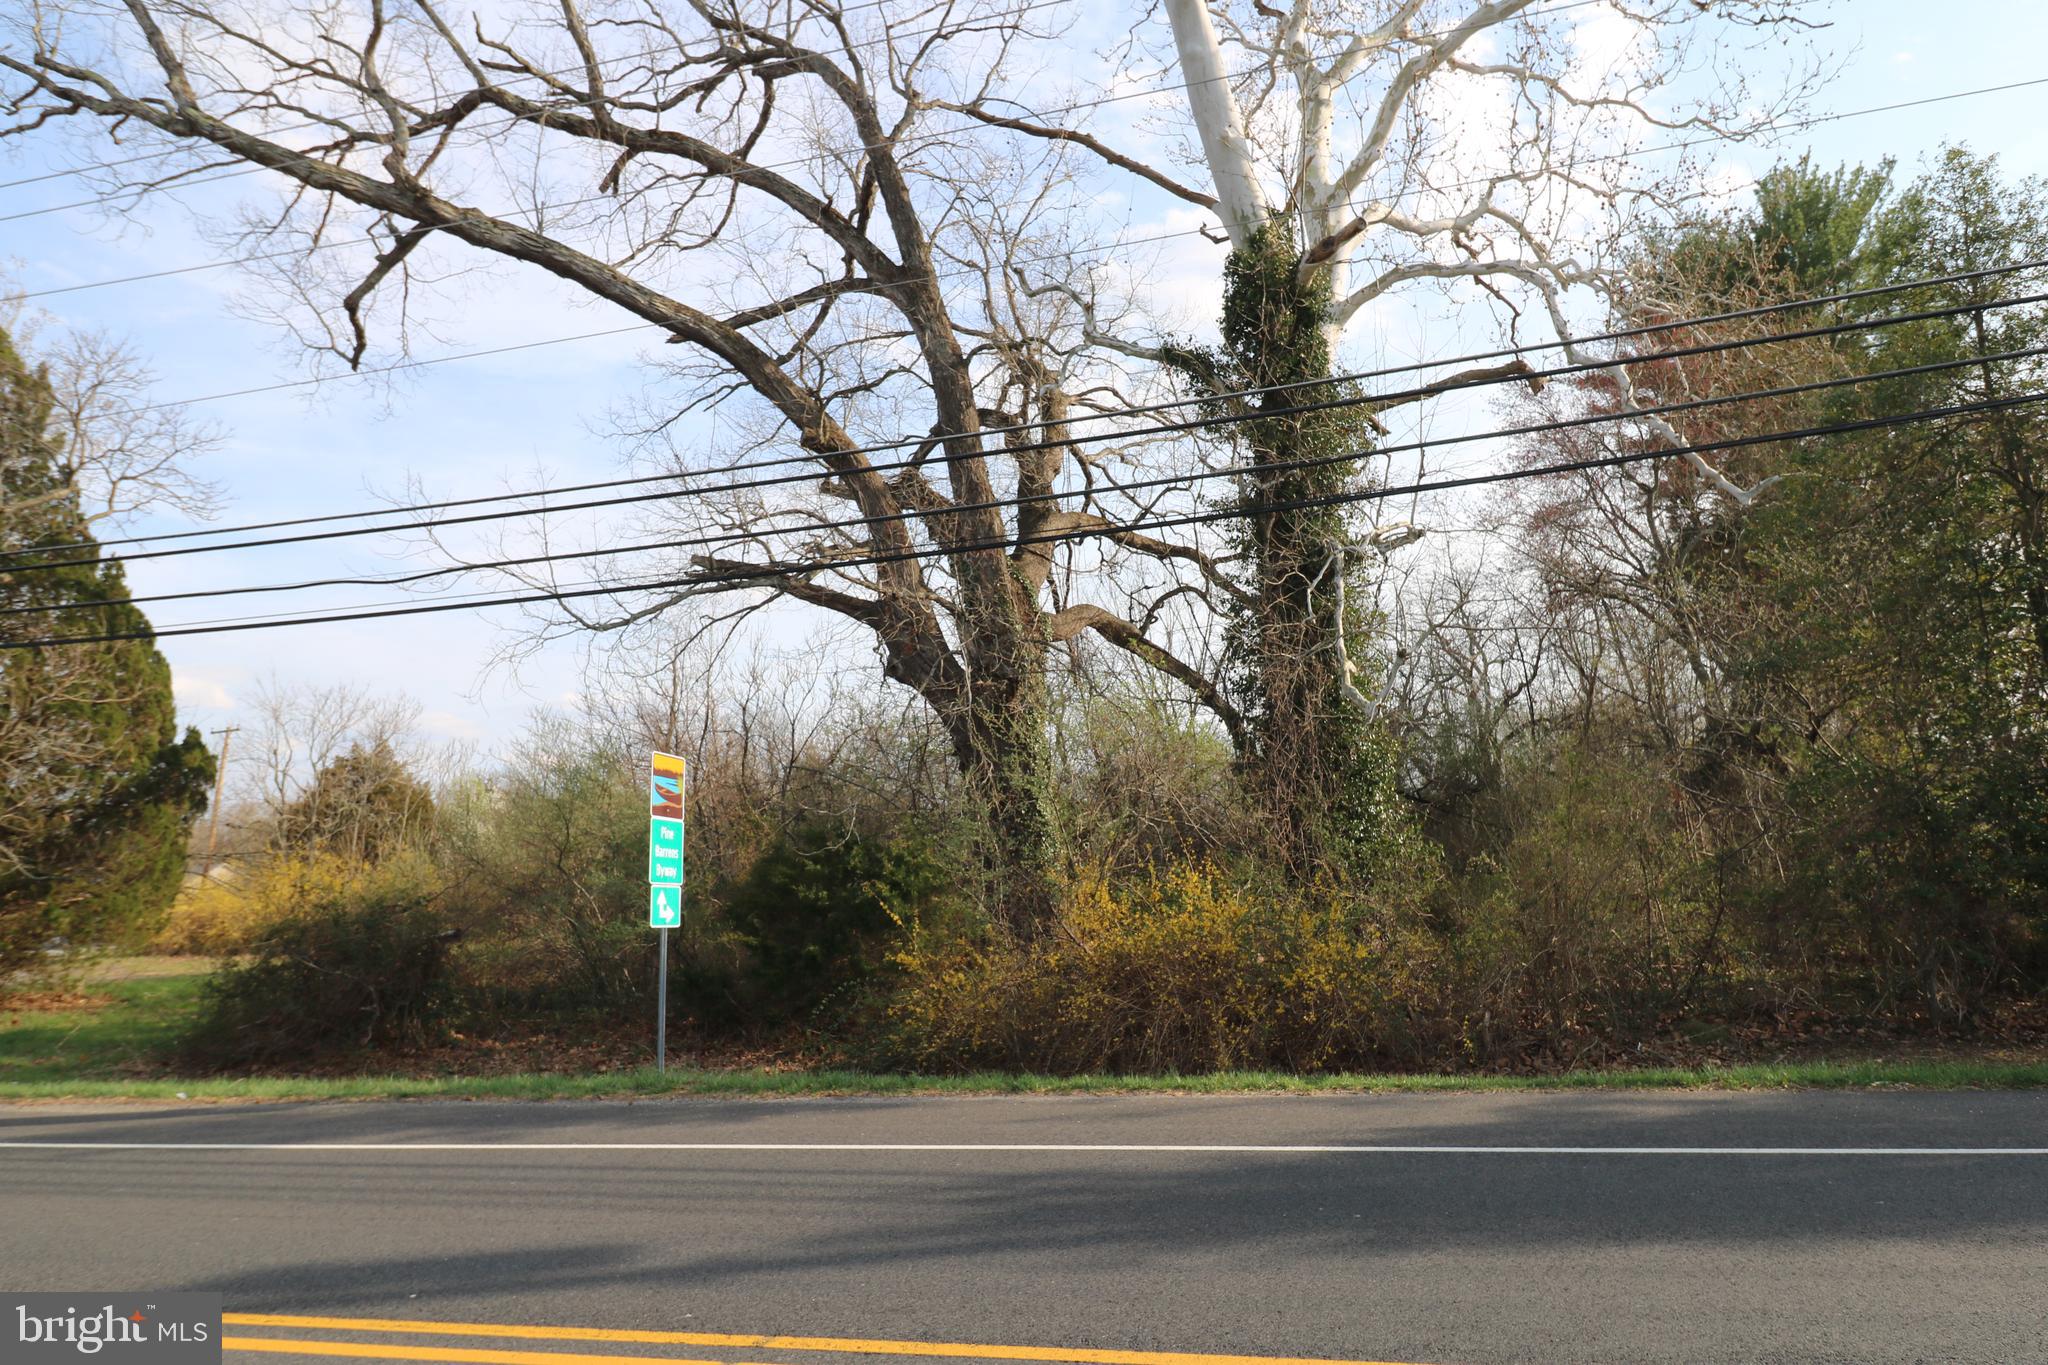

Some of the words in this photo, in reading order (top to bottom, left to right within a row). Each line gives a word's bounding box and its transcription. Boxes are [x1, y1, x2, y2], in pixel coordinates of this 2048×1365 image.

[660, 826, 674, 840] Pine
[655, 844, 679, 859] Barrens
[656, 863, 677, 879] Byway
